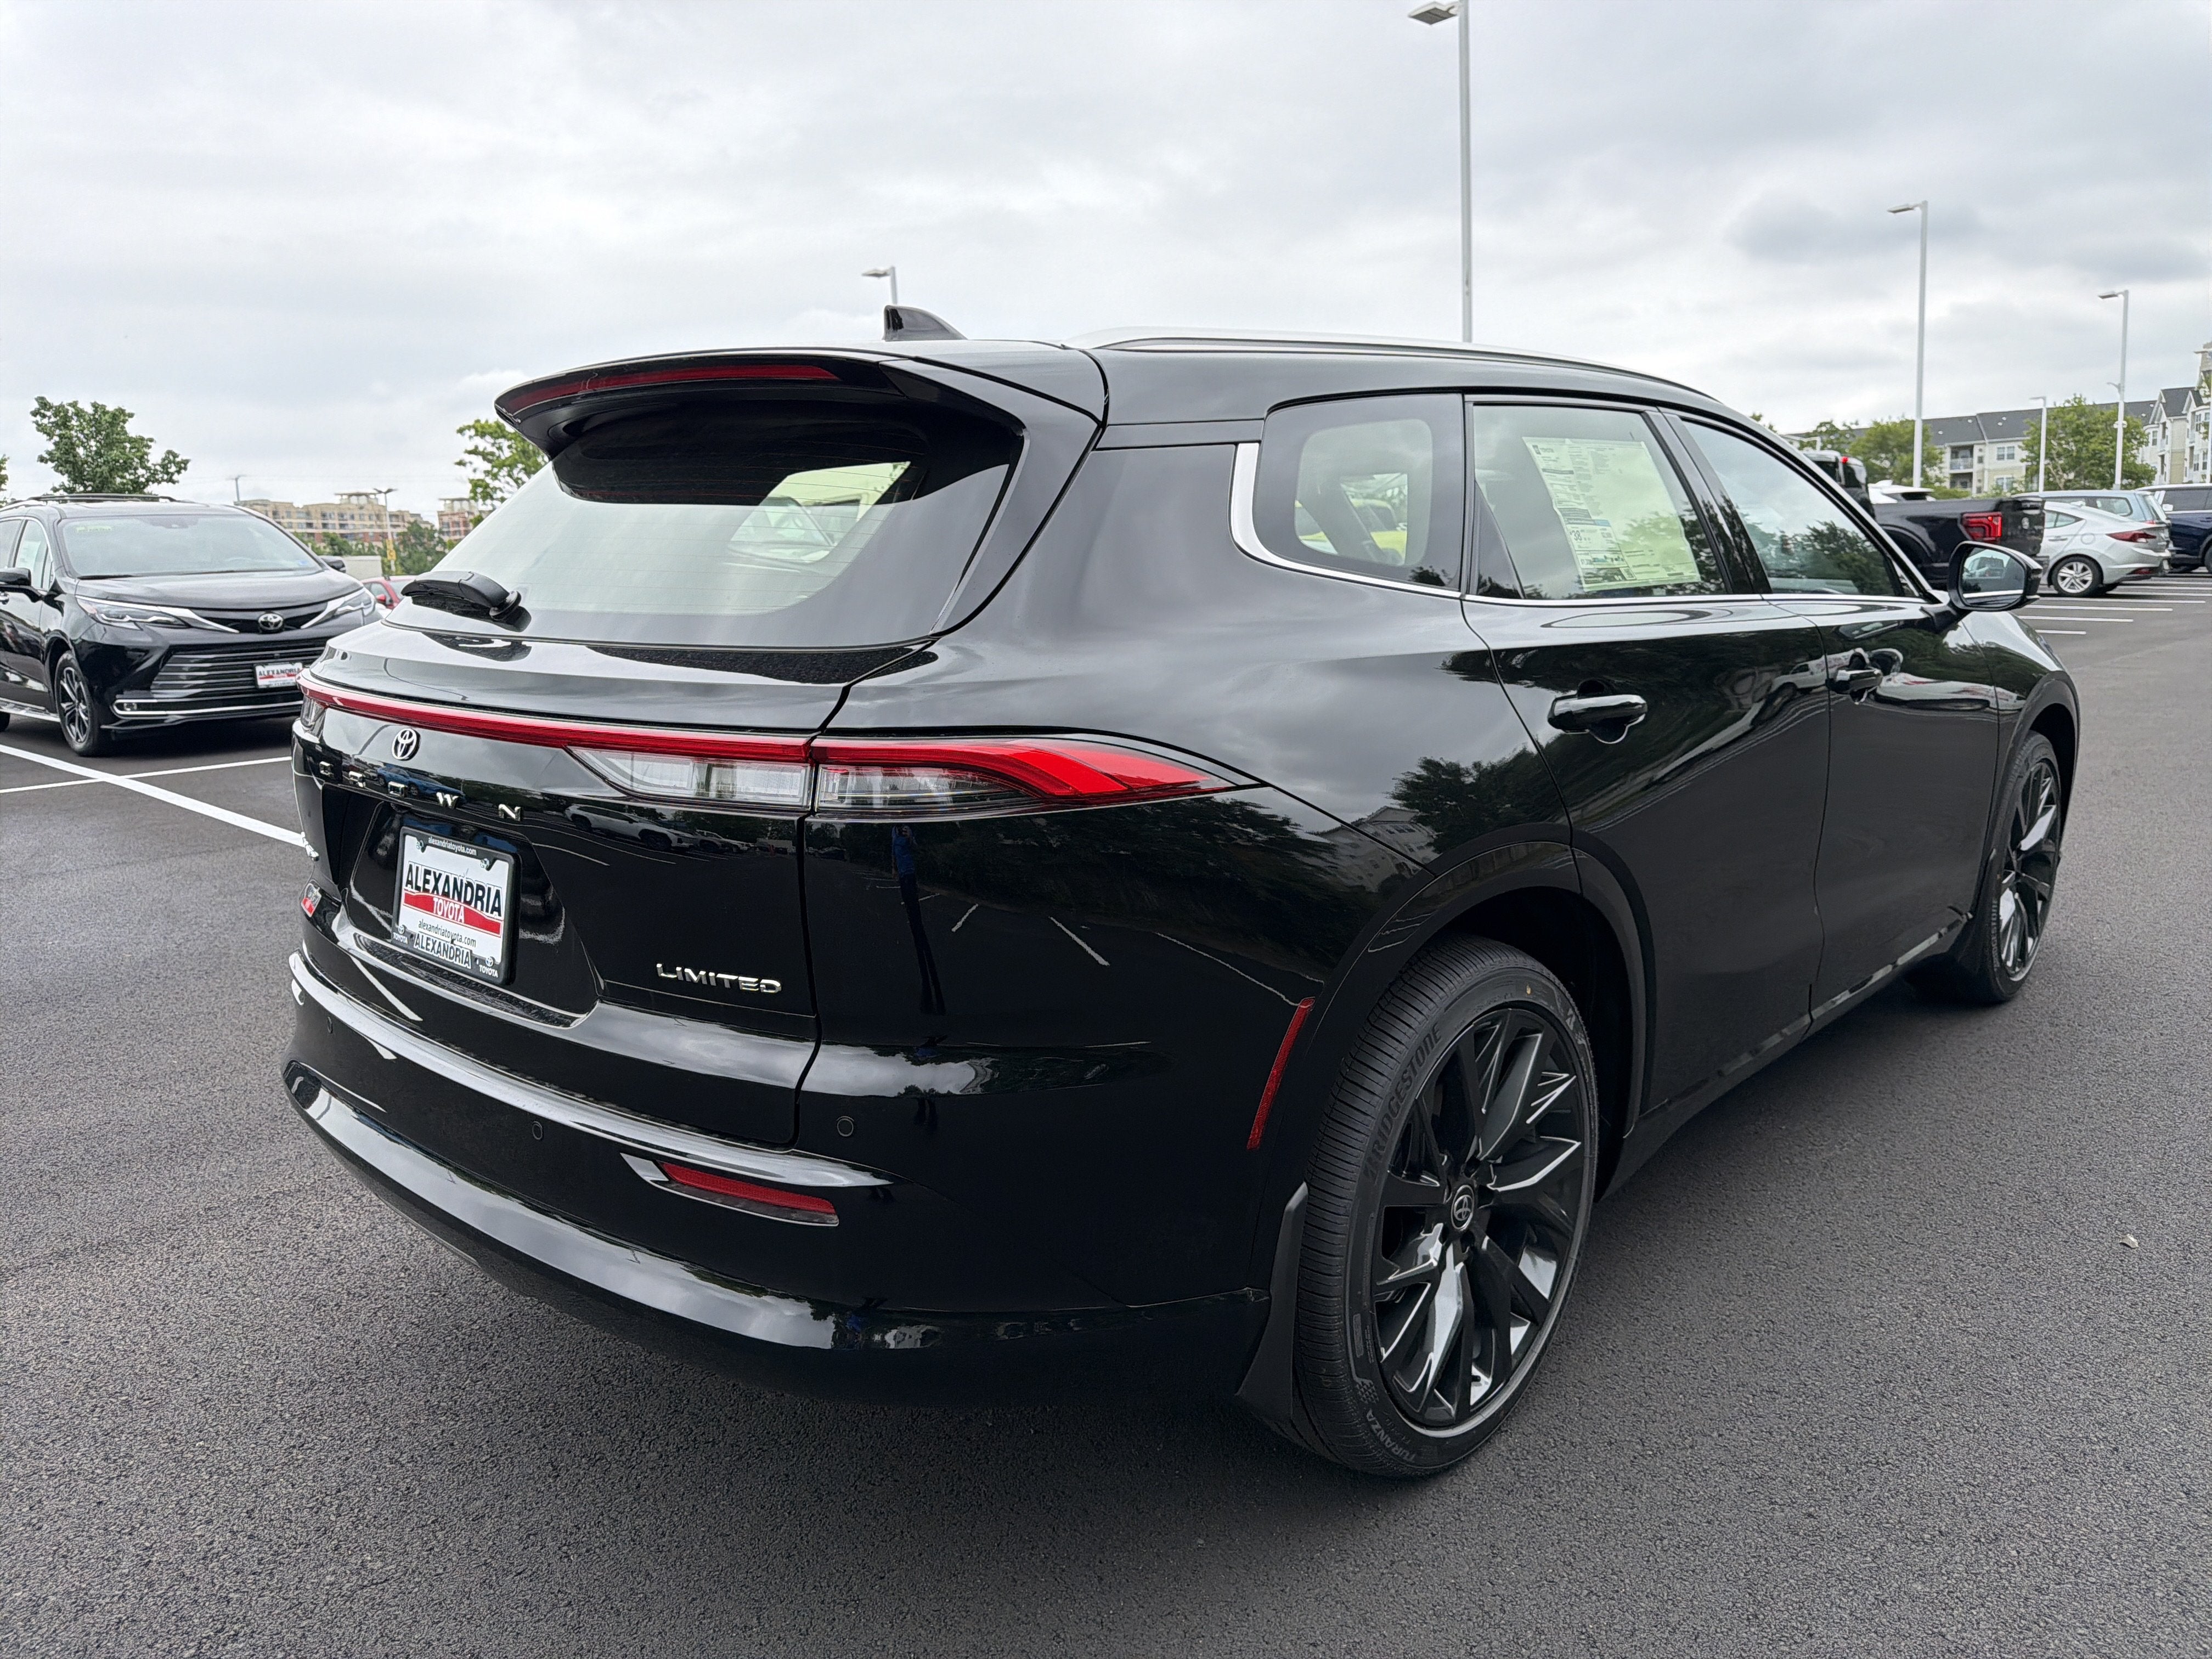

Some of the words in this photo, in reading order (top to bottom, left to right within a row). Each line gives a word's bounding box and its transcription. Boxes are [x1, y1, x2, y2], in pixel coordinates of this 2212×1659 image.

[319, 761, 522, 821] CROWN
[428, 836, 477, 856] alexandriatoyota.com
[405, 863, 503, 917] ALEXANDRIA
[433, 898, 465, 923] TOYOTA
[393, 932, 408, 944] TOYOTA
[418, 919, 477, 948] alexandriatoyota.com
[415, 933, 471, 968] ALEXANDRIA
[479, 963, 498, 978] TOYOTA
[656, 963, 782, 993] LIMITED
[1366, 1408, 1415, 1463] TURANZA
